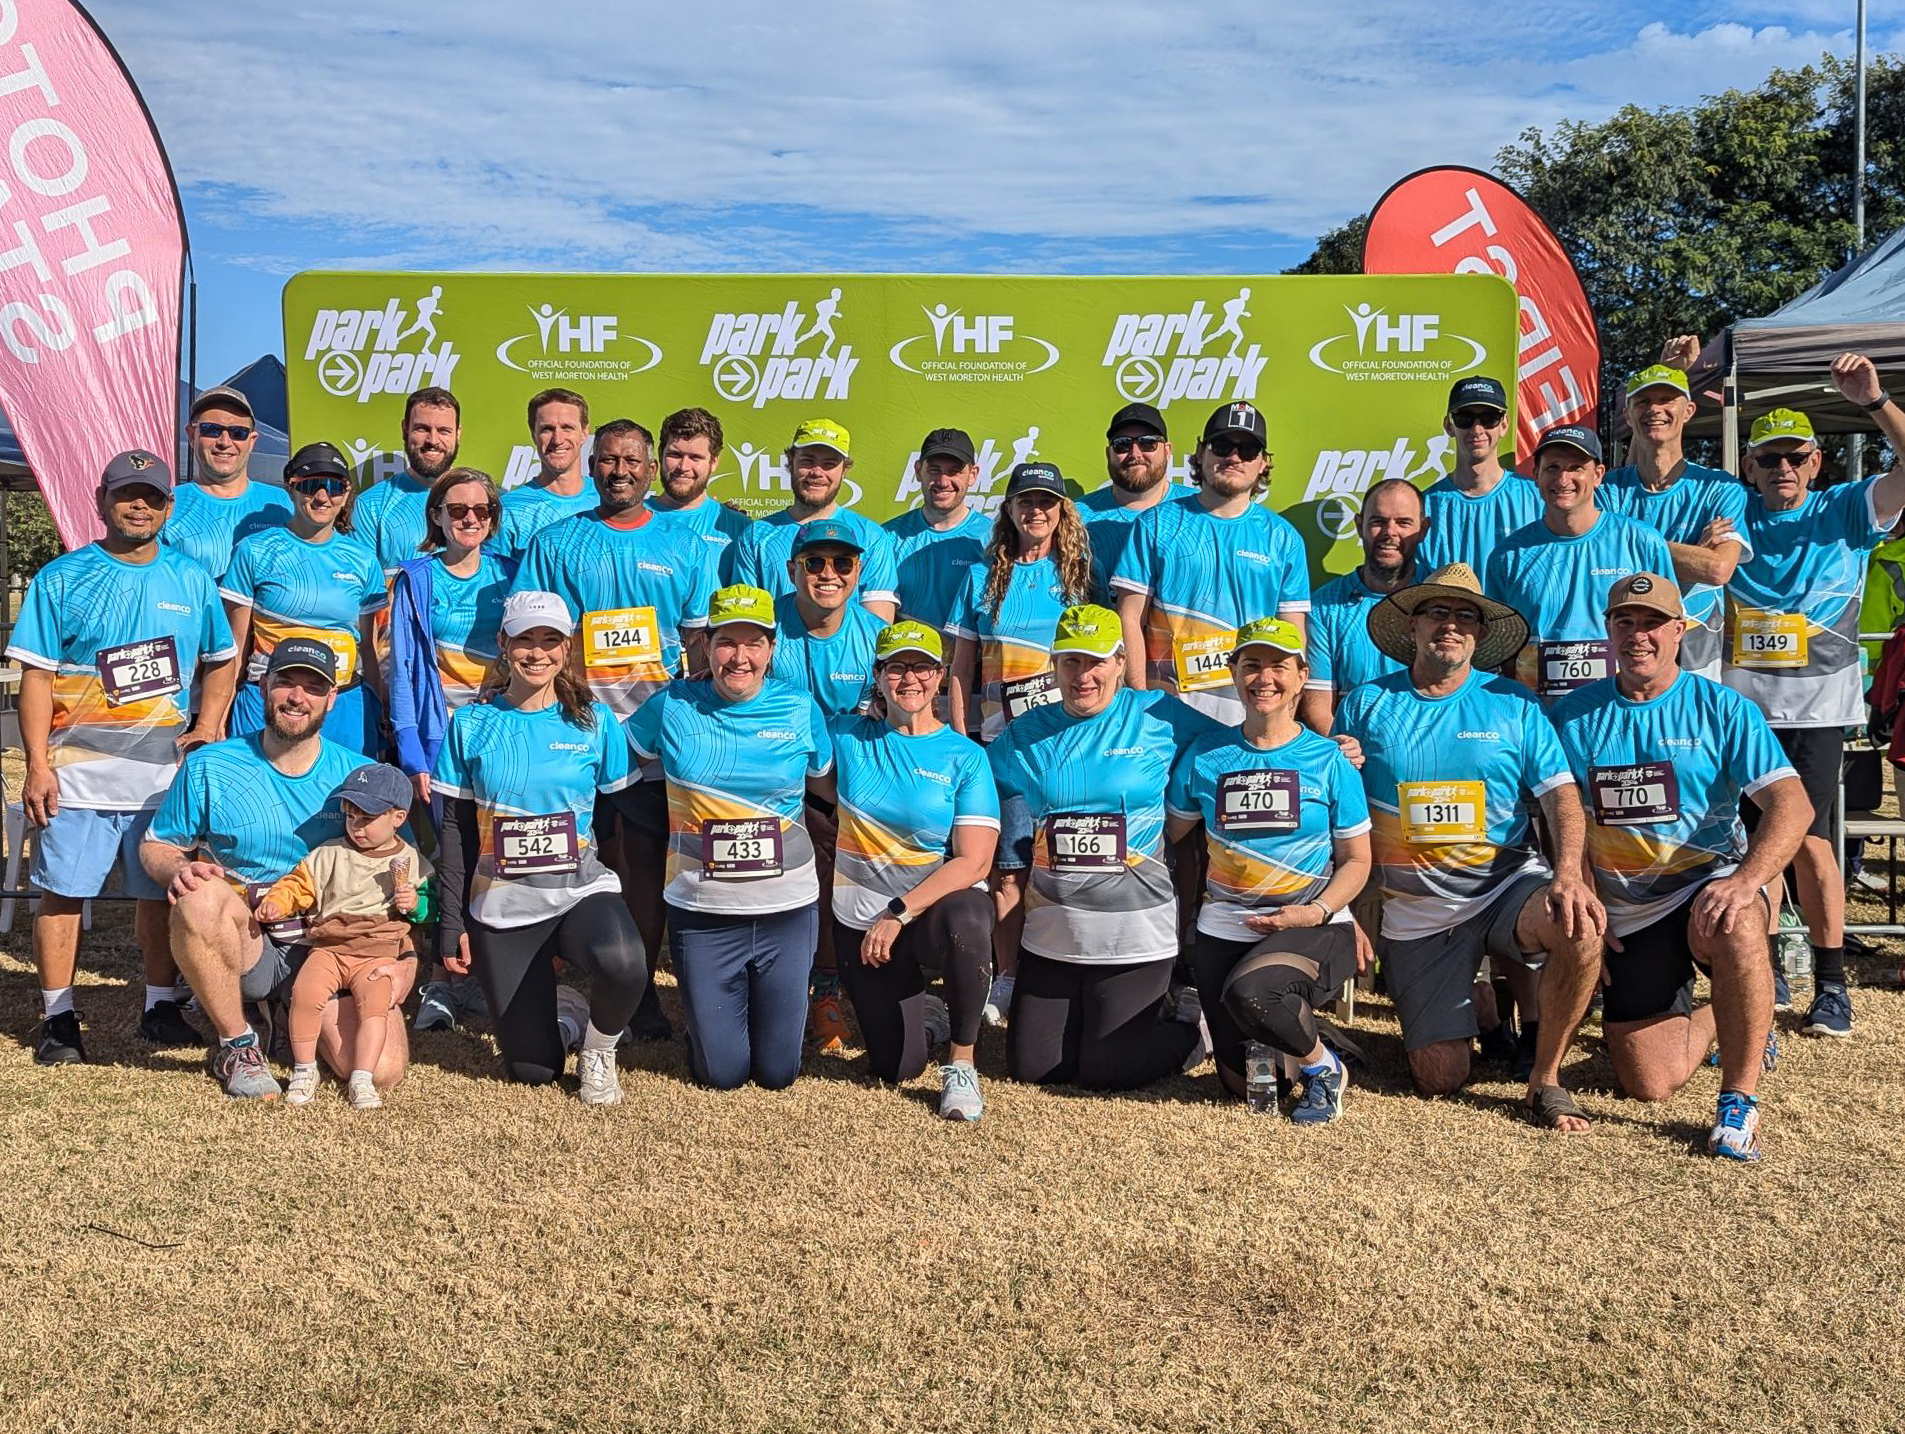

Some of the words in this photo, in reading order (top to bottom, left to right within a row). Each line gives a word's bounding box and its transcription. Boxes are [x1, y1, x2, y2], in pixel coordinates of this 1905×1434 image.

[304, 298, 407, 360] park
[700, 301, 806, 364] park
[1101, 301, 1214, 366] park
[357, 341, 461, 403] park
[528, 360, 562, 369] OFFICIAL
[565, 360, 618, 369] FOUNDATION
[620, 361, 632, 370] OF
[921, 361, 957, 370] OFFICIAL
[960, 361, 1014, 370] FOUNDATION
[1016, 361, 1028, 370] OF
[1342, 361, 1379, 370] OFFICIAL
[1382, 361, 1438, 370] FOUNDATION
[1440, 361, 1452, 370] OF
[531, 371, 553, 380] WEST
[555, 371, 595, 380] MORETON
[598, 372, 628, 381] HEALTH
[752, 345, 860, 408] park
[926, 373, 947, 381] WEST
[950, 373, 990, 381] MORETON
[992, 373, 1024, 381] HEALTH
[1157, 344, 1269, 409] park
[1346, 372, 1369, 381] WEST
[1371, 372, 1413, 381] MORETON
[1416, 372, 1449, 381] HEALTH
[1237, 411, 1247, 427] 1
[1022, 468, 1055, 479] cleanco
[1302, 437, 1417, 503] park
[1236, 549, 1271, 564] cleanco
[637, 561, 674, 575] cleanco
[1590, 567, 1630, 577] cleanco
[157, 600, 191, 614] cleanco
[603, 629, 641, 647] 1244
[1749, 635, 1787, 651] 1349
[287, 645, 327, 661] cleanco
[128, 661, 161, 683] 228
[829, 670, 866, 682] cleanco
[1559, 661, 1592, 679] 760
[757, 729, 796, 741] cleanco
[1457, 730, 1500, 740] cleanco
[1657, 737, 1702, 747] cleanco
[549, 740, 590, 753] cleanco
[1103, 746, 1144, 758] cleanco
[913, 765, 952, 784] cleanco
[1239, 791, 1274, 810] 470
[1614, 787, 1648, 806] 770
[1424, 804, 1459, 823] 1311
[518, 837, 554, 856] 542
[727, 841, 762, 860] 433
[1069, 835, 1101, 854] 166
